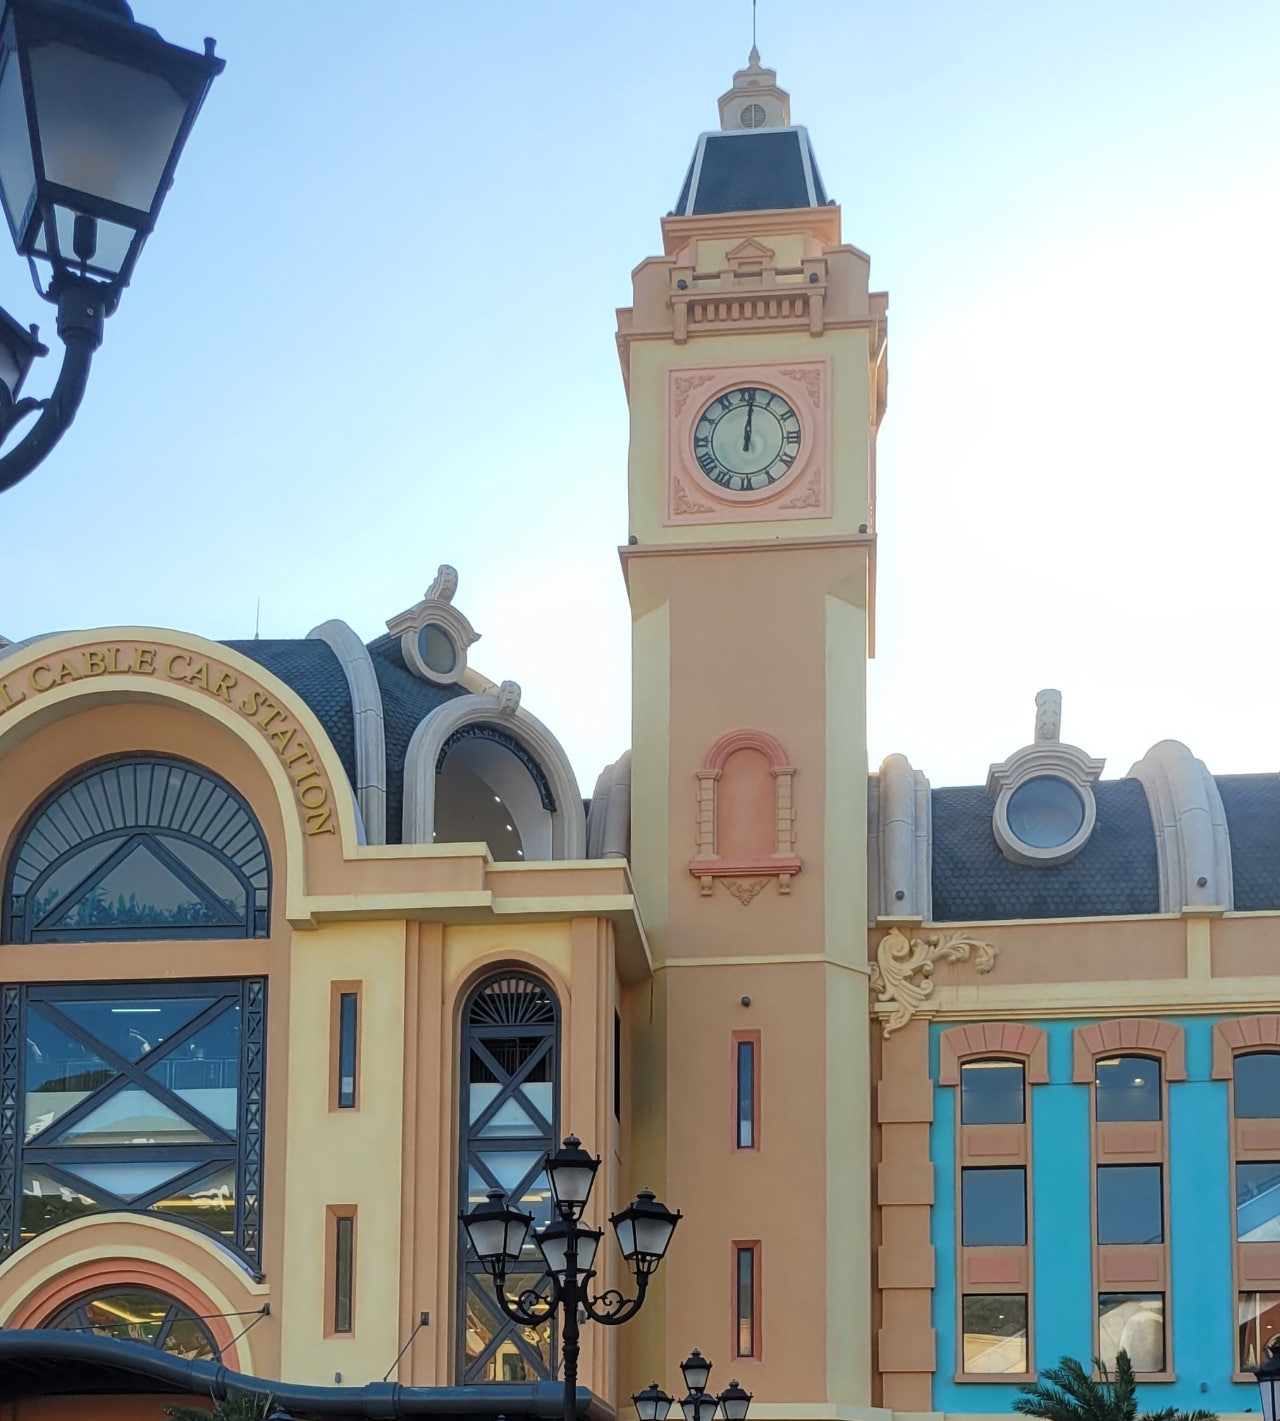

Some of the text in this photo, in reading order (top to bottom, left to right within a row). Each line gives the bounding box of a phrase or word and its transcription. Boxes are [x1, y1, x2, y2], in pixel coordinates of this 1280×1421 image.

[780, 408, 795, 422] II
[787, 430, 800, 444] III
[0, 648, 335, 838] L CABLE CAR STATION
